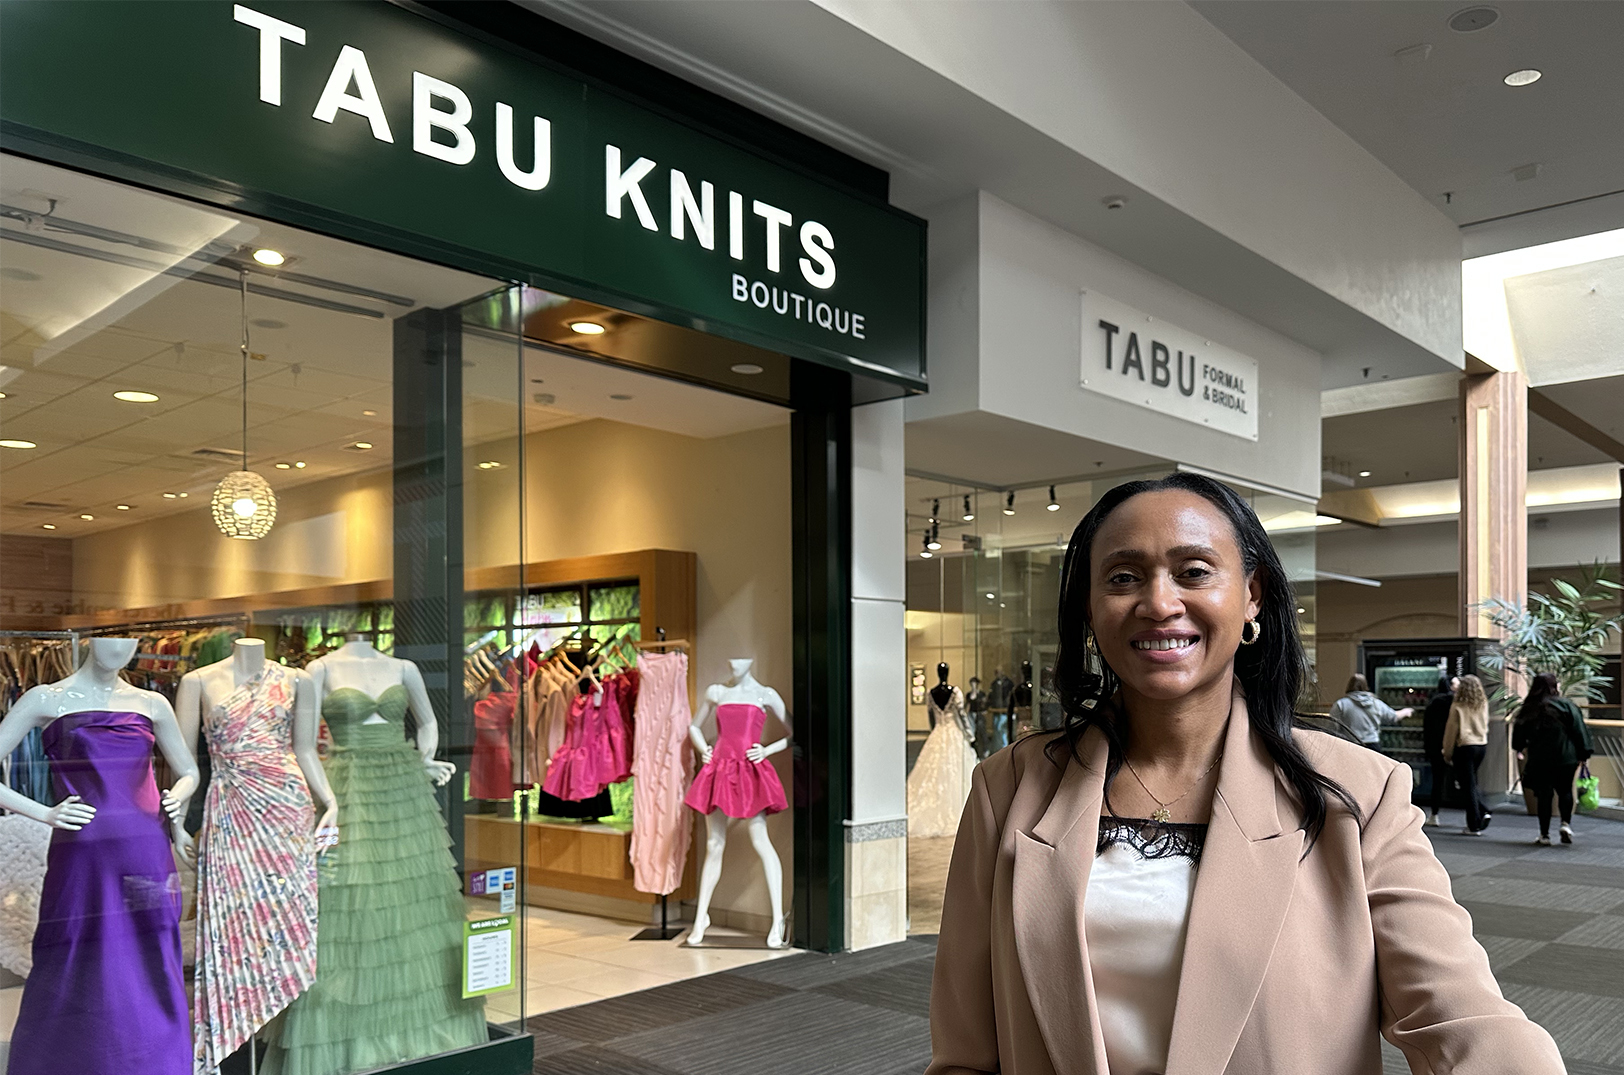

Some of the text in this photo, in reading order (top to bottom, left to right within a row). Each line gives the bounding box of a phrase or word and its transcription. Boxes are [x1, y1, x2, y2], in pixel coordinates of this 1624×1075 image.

[233, 4, 836, 290] TABU KNITS
[732, 273, 866, 340] BOUTIQUE
[1099, 319, 1195, 397] TABU
[1203, 364, 1246, 394] FORMAL
[1203, 385, 1248, 415] & BRIDAL
